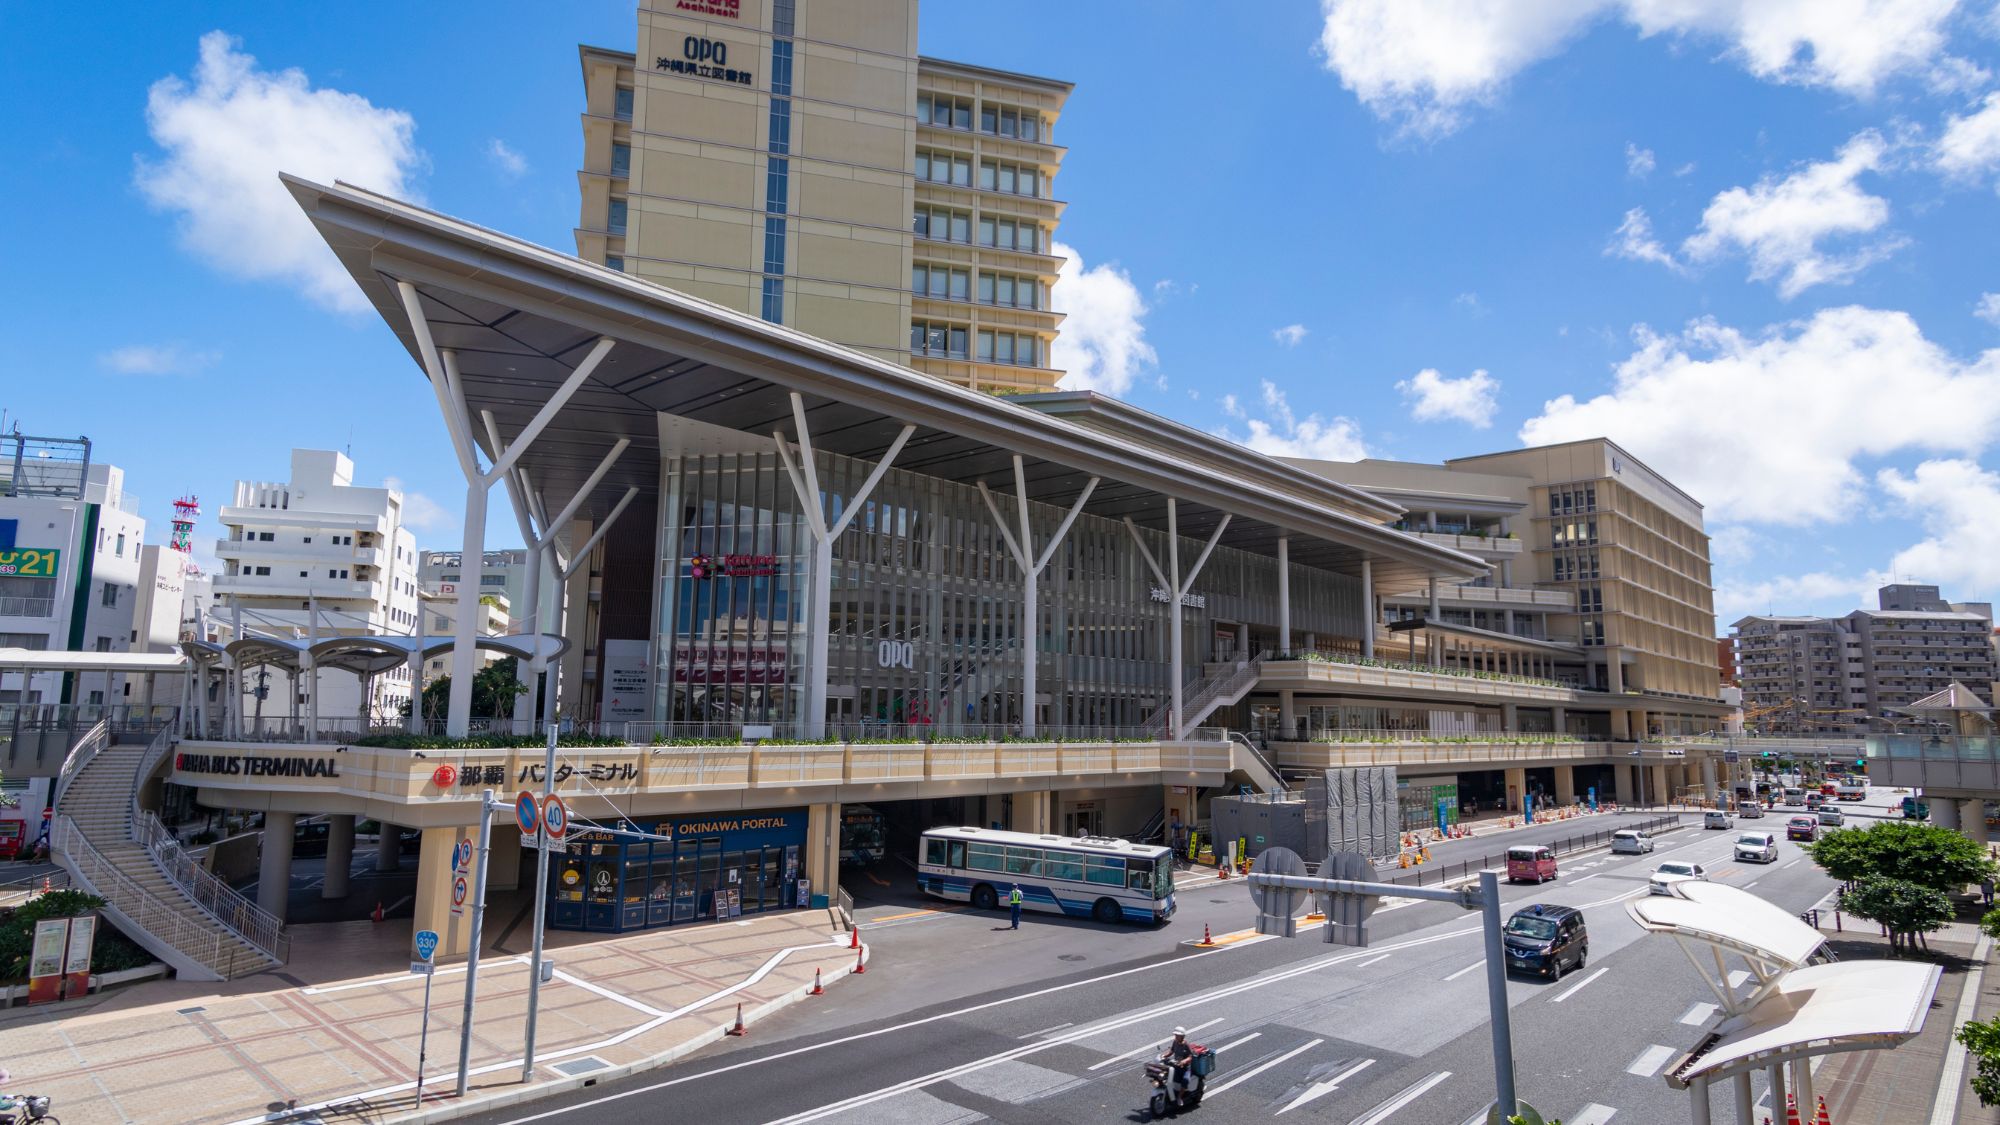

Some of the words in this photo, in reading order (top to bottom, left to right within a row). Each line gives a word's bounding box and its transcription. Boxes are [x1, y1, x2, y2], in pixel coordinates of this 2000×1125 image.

[676, 1, 739, 19] Asahibashi
[656, 57, 752, 85] 沖縄県立図書館
[1151, 587, 1205, 608] 沖縄図書館
[211, 756, 241, 775] BUS
[242, 757, 340, 778] TERMINAL
[460, 765, 505, 786] 那覇
[547, 806, 561, 826] 40
[678, 821, 738, 834] OKINAWA
[741, 818, 787, 830] PORTAL
[419, 937, 434, 949] 330
